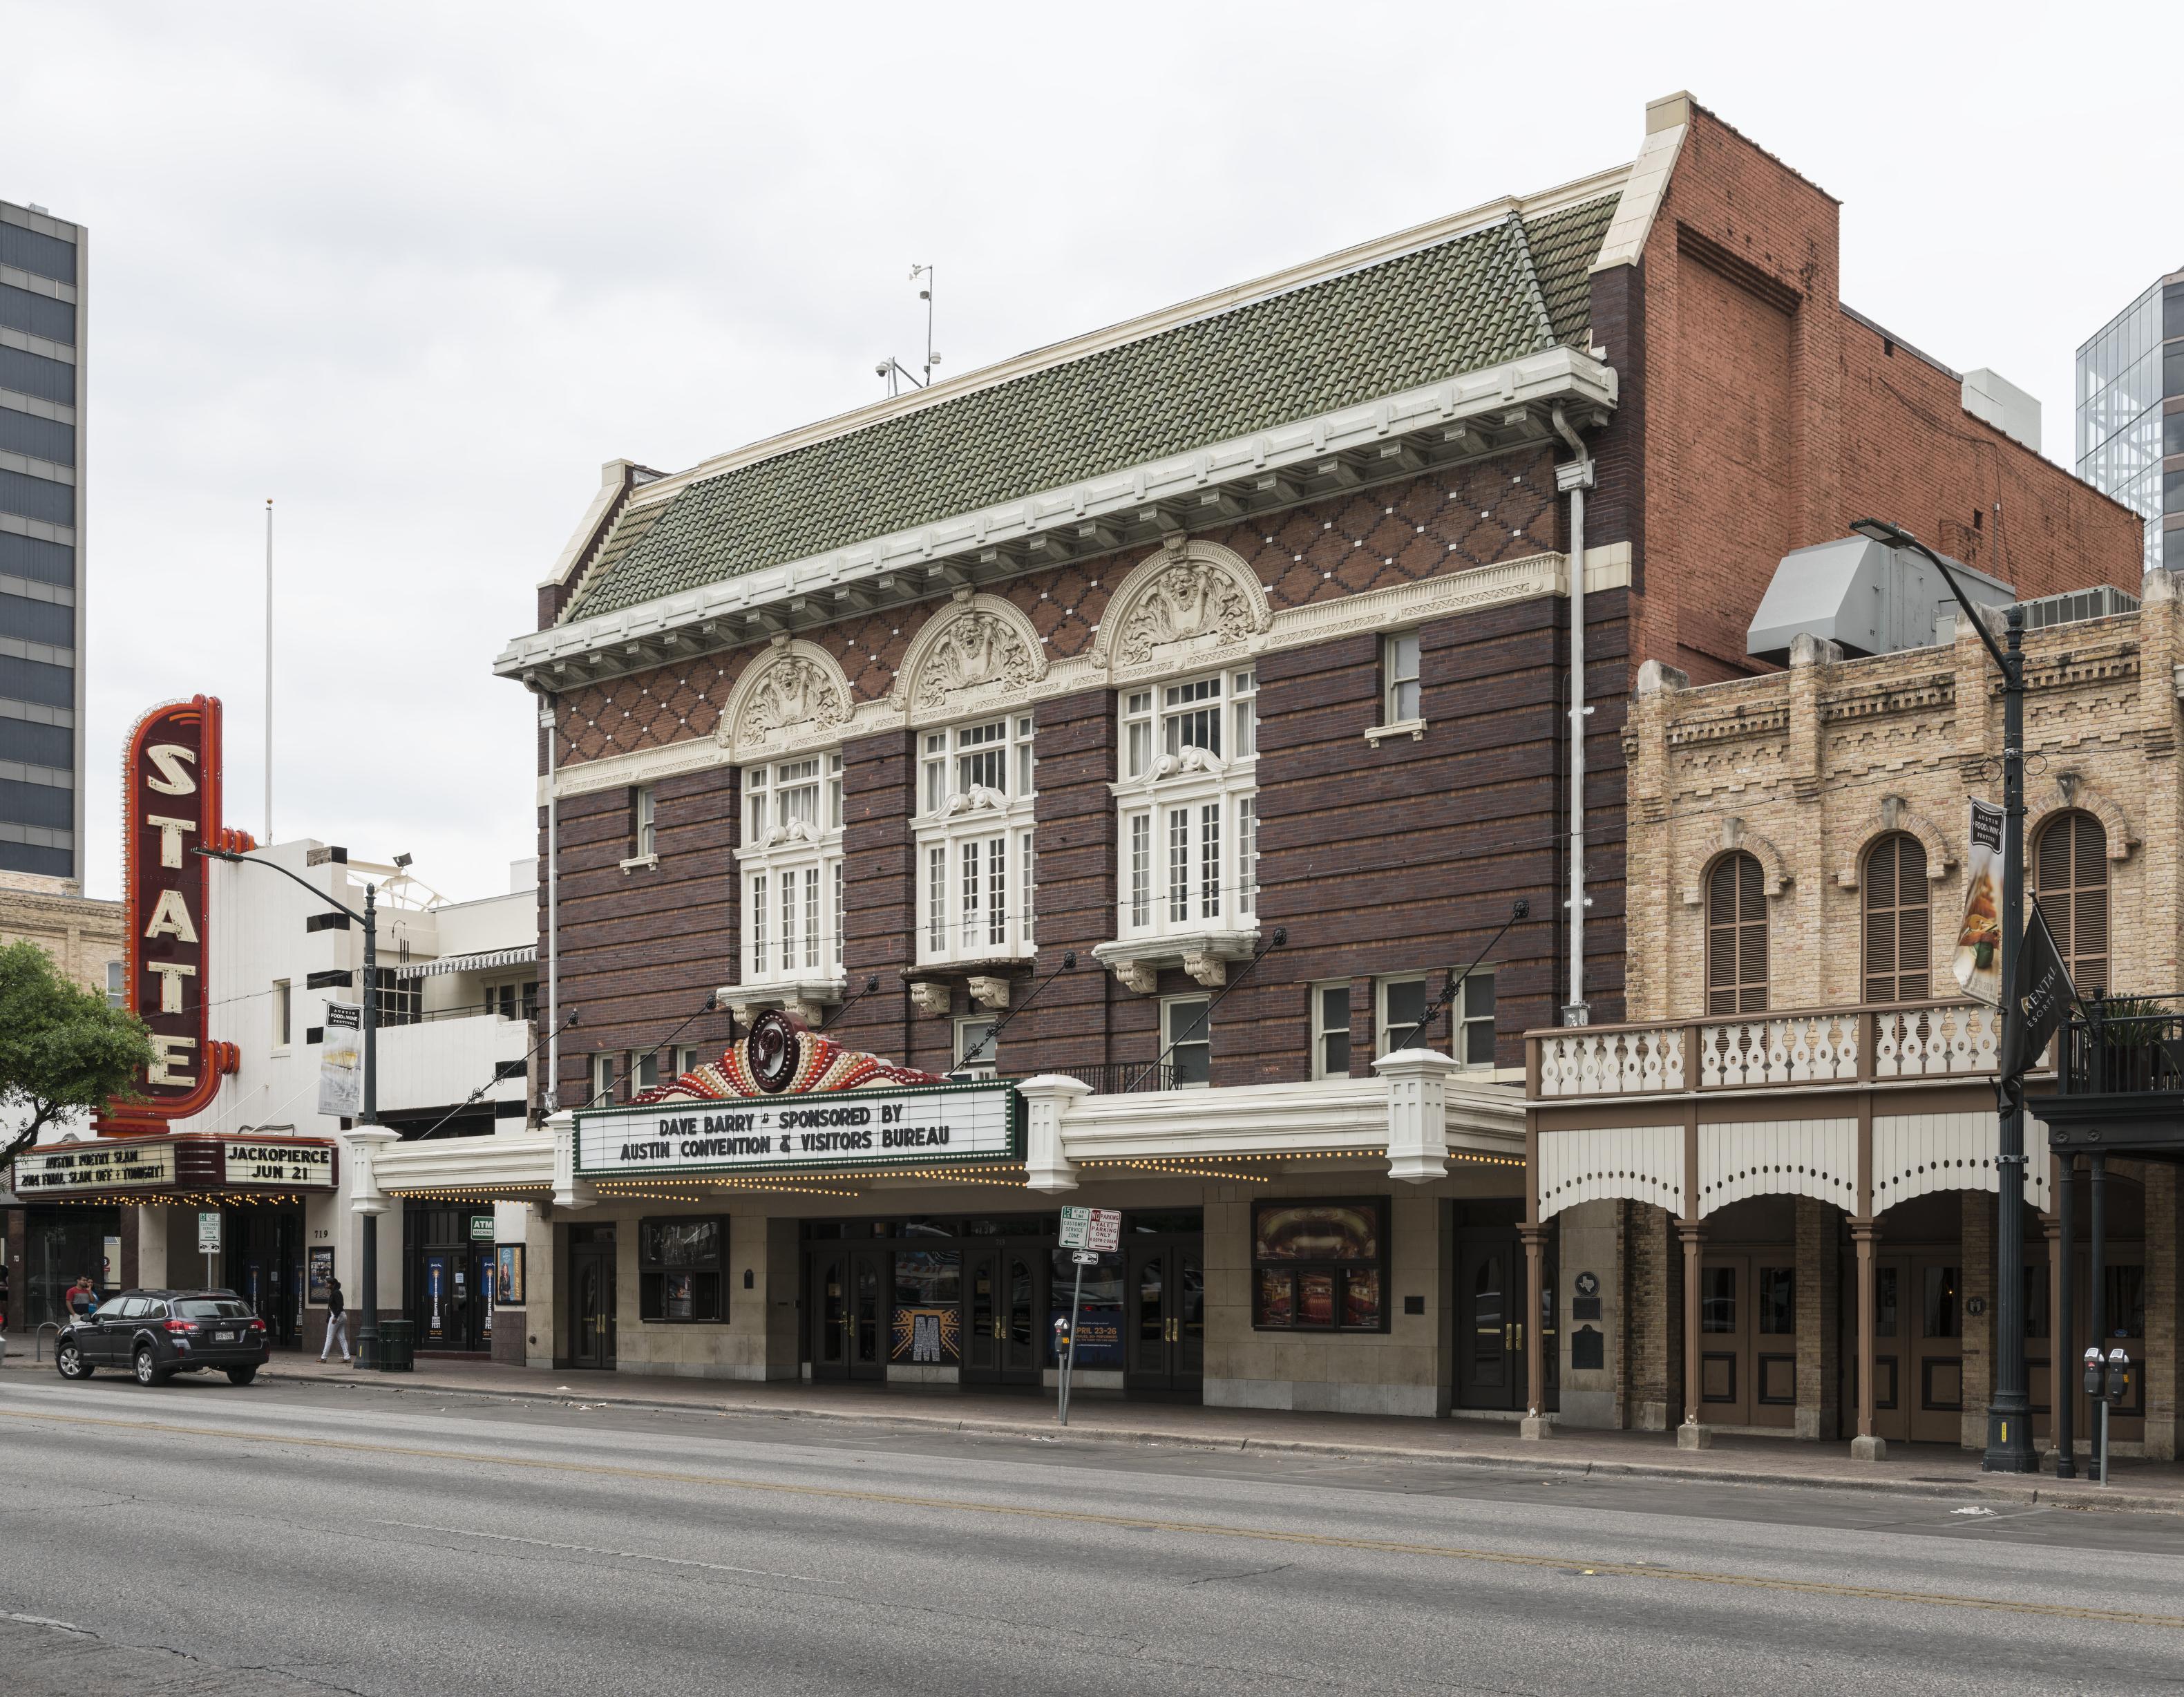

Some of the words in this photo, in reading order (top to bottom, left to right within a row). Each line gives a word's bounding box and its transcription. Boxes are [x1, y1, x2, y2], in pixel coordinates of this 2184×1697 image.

[1978, 814, 1999, 826] AUSTIN
[144, 744, 199, 1088] STATE
[2026, 994, 2055, 1030] ESORTS
[659, 1117, 697, 1136] DAVE
[704, 1113, 754, 1133] BARRY
[779, 1107, 871, 1129] SPONSORED
[882, 1104, 902, 1123] BY
[620, 1141, 670, 1160] AUSTIN
[681, 1136, 770, 1157] CONVENTION
[780, 1135, 790, 1153] &
[801, 1130, 872, 1151] VISITORS
[882, 1126, 949, 1148] BUREAU
[46, 1155, 75, 1169] AUSTIN
[79, 1152, 109, 1166] POETRY
[114, 1149, 138, 1163] SLAM
[228, 1146, 330, 1164] JACKOPIERCE
[21, 1175, 39, 1187] 2014
[42, 1173, 66, 1186] FINAL
[69, 1170, 92, 1184] SLAM
[96, 1168, 112, 1182] OFF
[251, 1165, 283, 1178] JUN
[292, 1166, 307, 1179] 21
[473, 1220, 493, 1229] ATM
[1092, 1211, 1100, 1220] NO
[314, 1230, 328, 1239] 719
